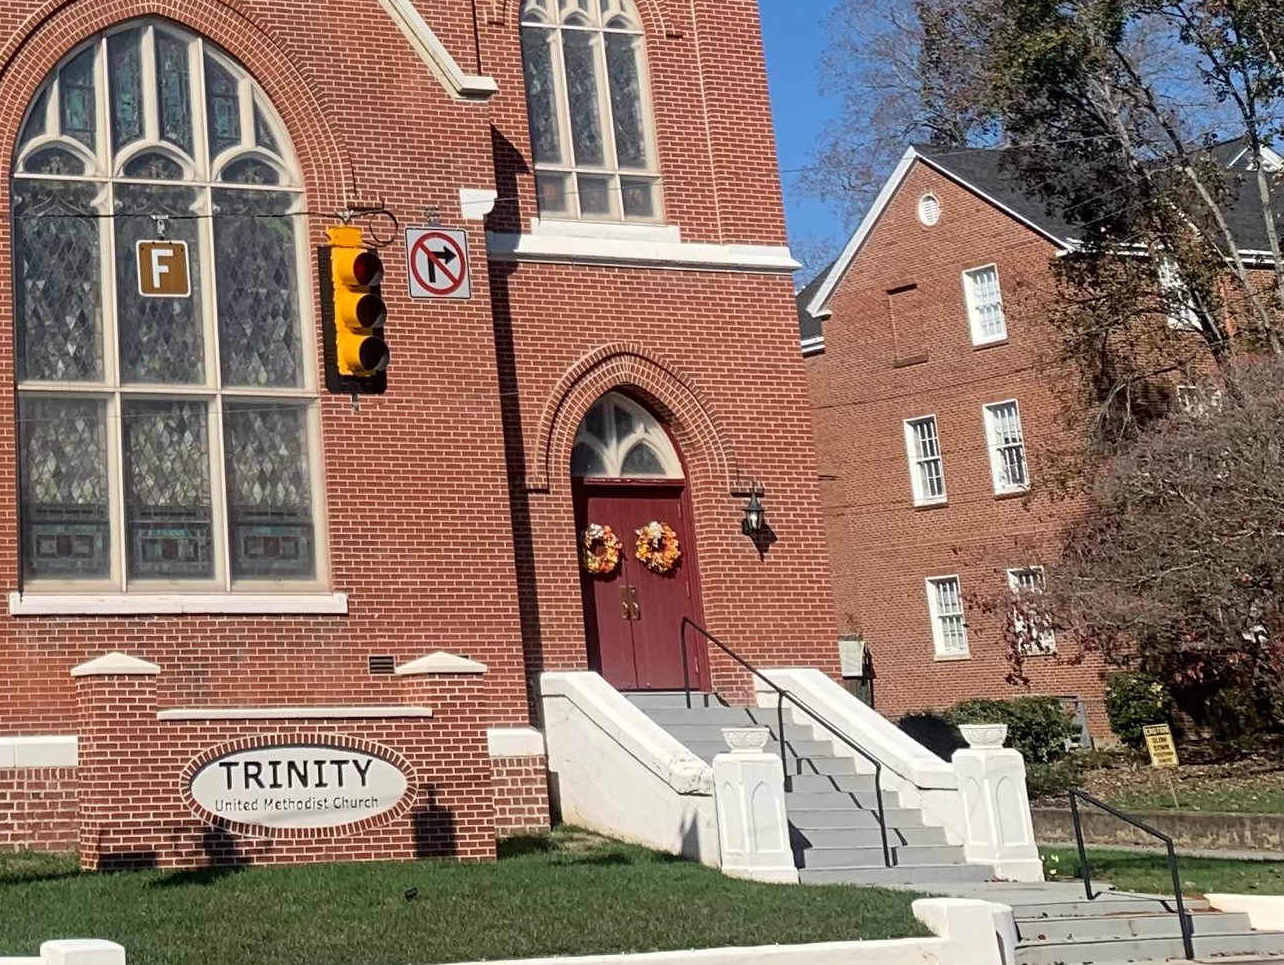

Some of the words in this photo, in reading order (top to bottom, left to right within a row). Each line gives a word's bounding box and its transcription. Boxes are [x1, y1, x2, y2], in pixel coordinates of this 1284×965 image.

[151, 248, 173, 288] F
[218, 759, 373, 790] TRINITY
[215, 798, 258, 812] United
[264, 796, 329, 811] Methodist
[333, 796, 379, 809] Church
